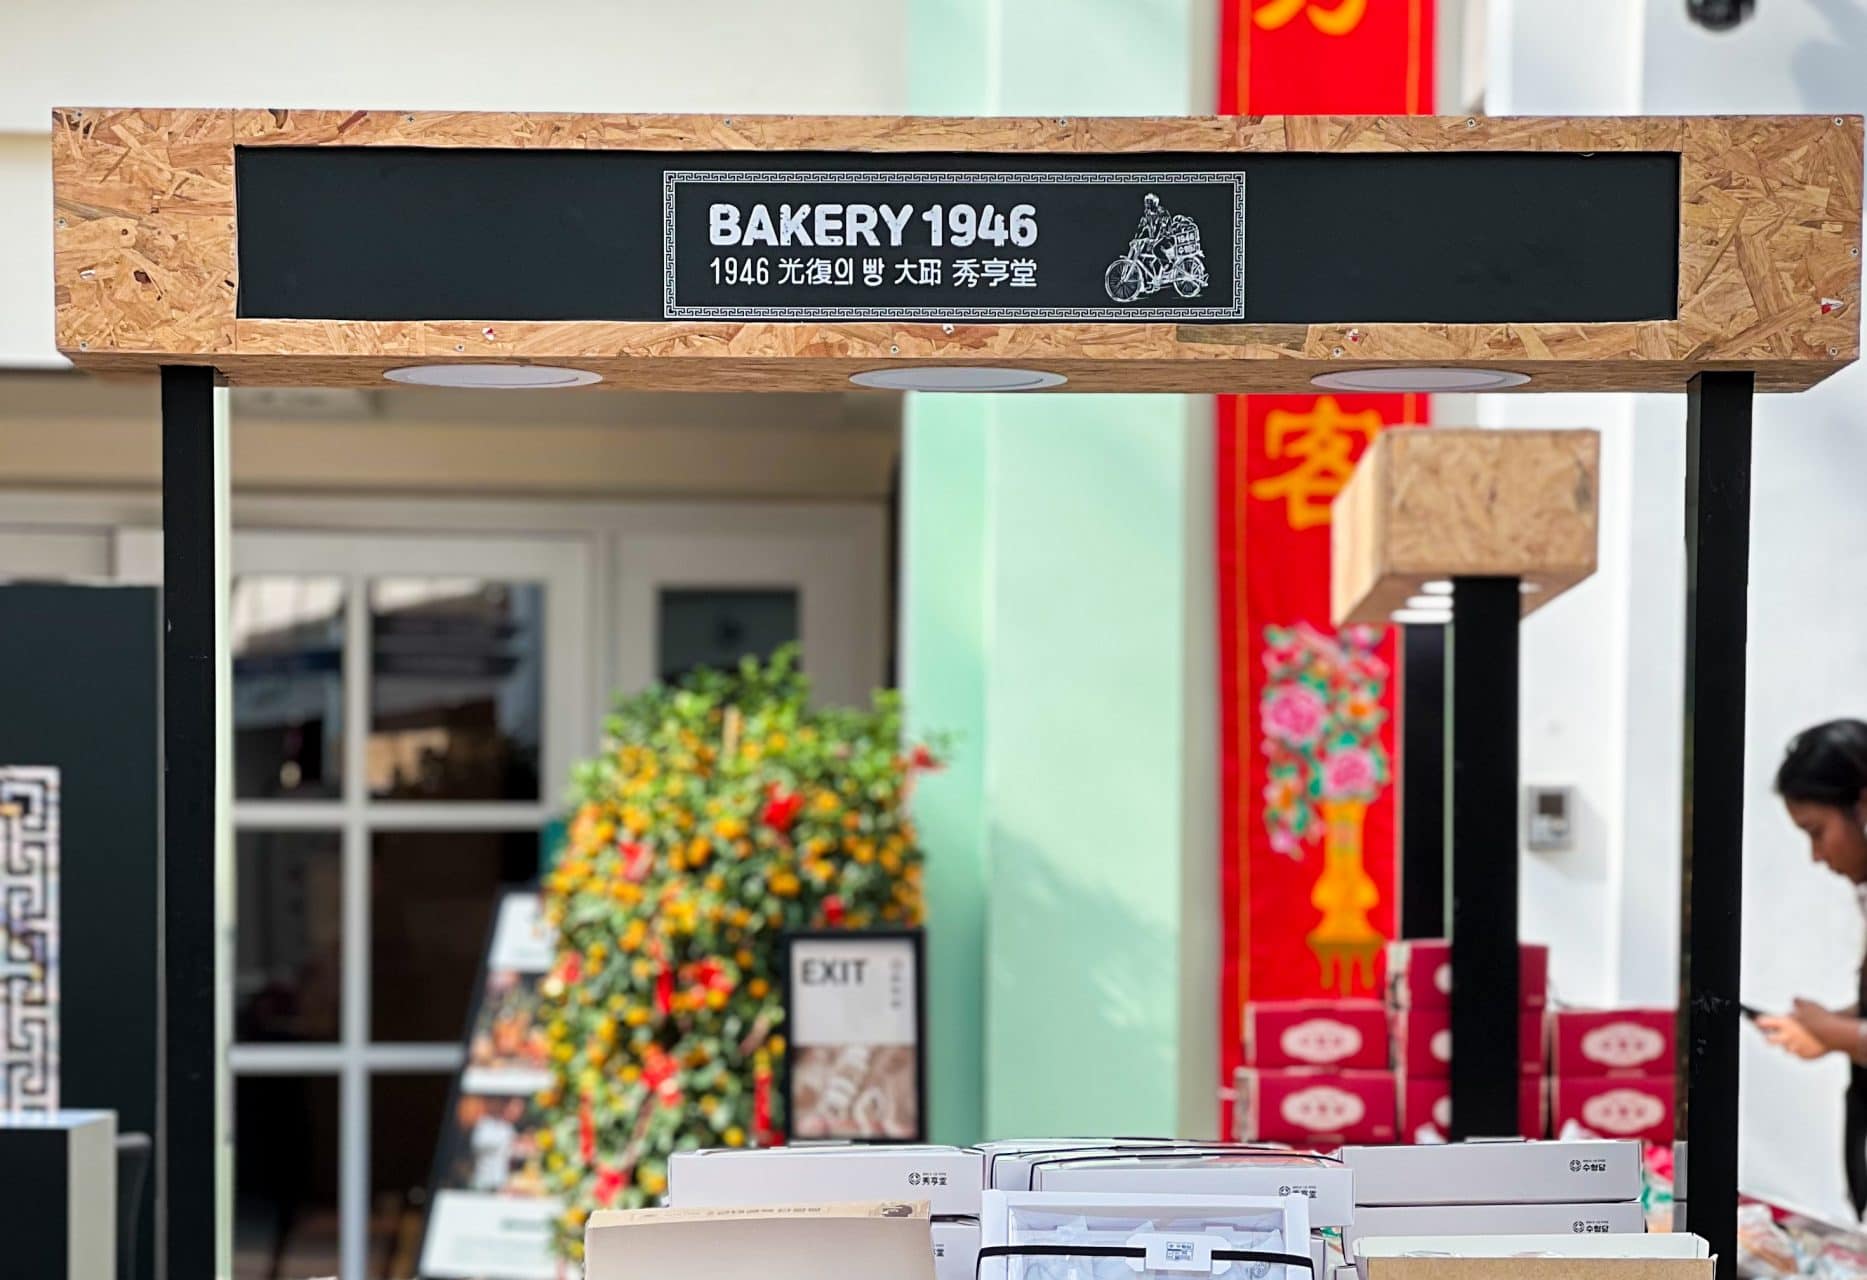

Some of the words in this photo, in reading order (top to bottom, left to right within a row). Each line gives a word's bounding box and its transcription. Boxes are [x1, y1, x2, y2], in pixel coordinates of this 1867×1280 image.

[709, 203, 914, 247] BAKERY
[922, 203, 1038, 247] 1946
[710, 257, 769, 285] 1946
[778, 257, 854, 286] 光復의
[862, 258, 885, 287] 빵
[895, 258, 942, 287] 大邱
[952, 258, 1037, 288] 秀亨堂
[802, 958, 868, 986] EXIT
